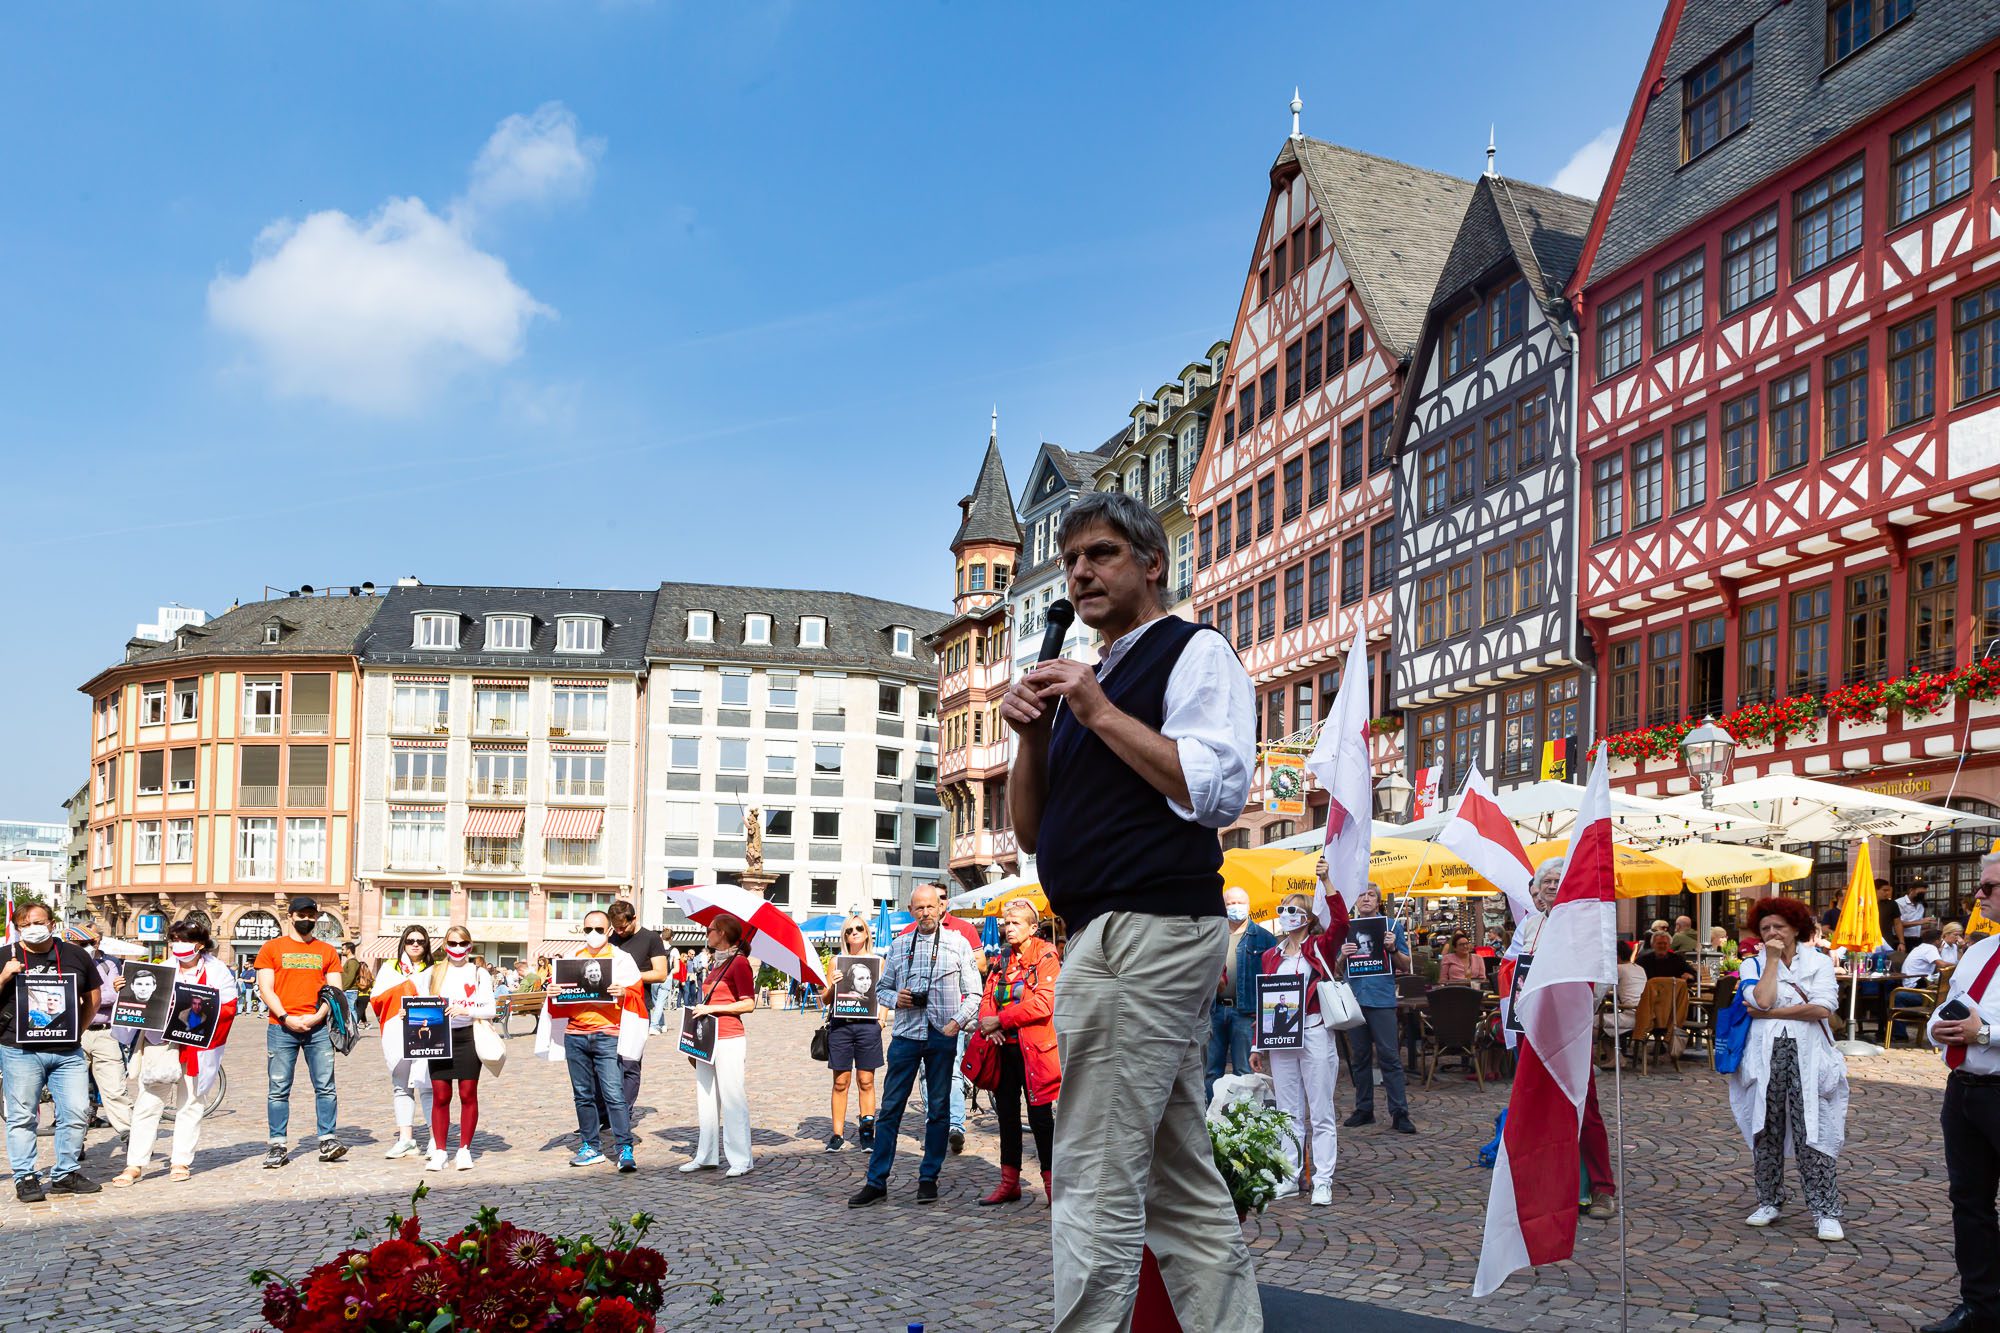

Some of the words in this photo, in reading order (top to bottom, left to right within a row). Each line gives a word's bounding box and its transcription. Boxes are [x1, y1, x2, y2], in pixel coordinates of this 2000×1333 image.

[140, 916, 158, 932] U
[239, 918, 275, 927] BRILLEN
[235, 926, 280, 938] WEISS
[116, 1007, 142, 1017] IHAR
[115, 1014, 146, 1024] LOSIK
[26, 1028, 68, 1037] GETÖTET
[171, 1029, 205, 1042] GETÖTET
[1263, 1036, 1296, 1045] GETÖTET
[410, 1047, 444, 1056] GETÖTET
